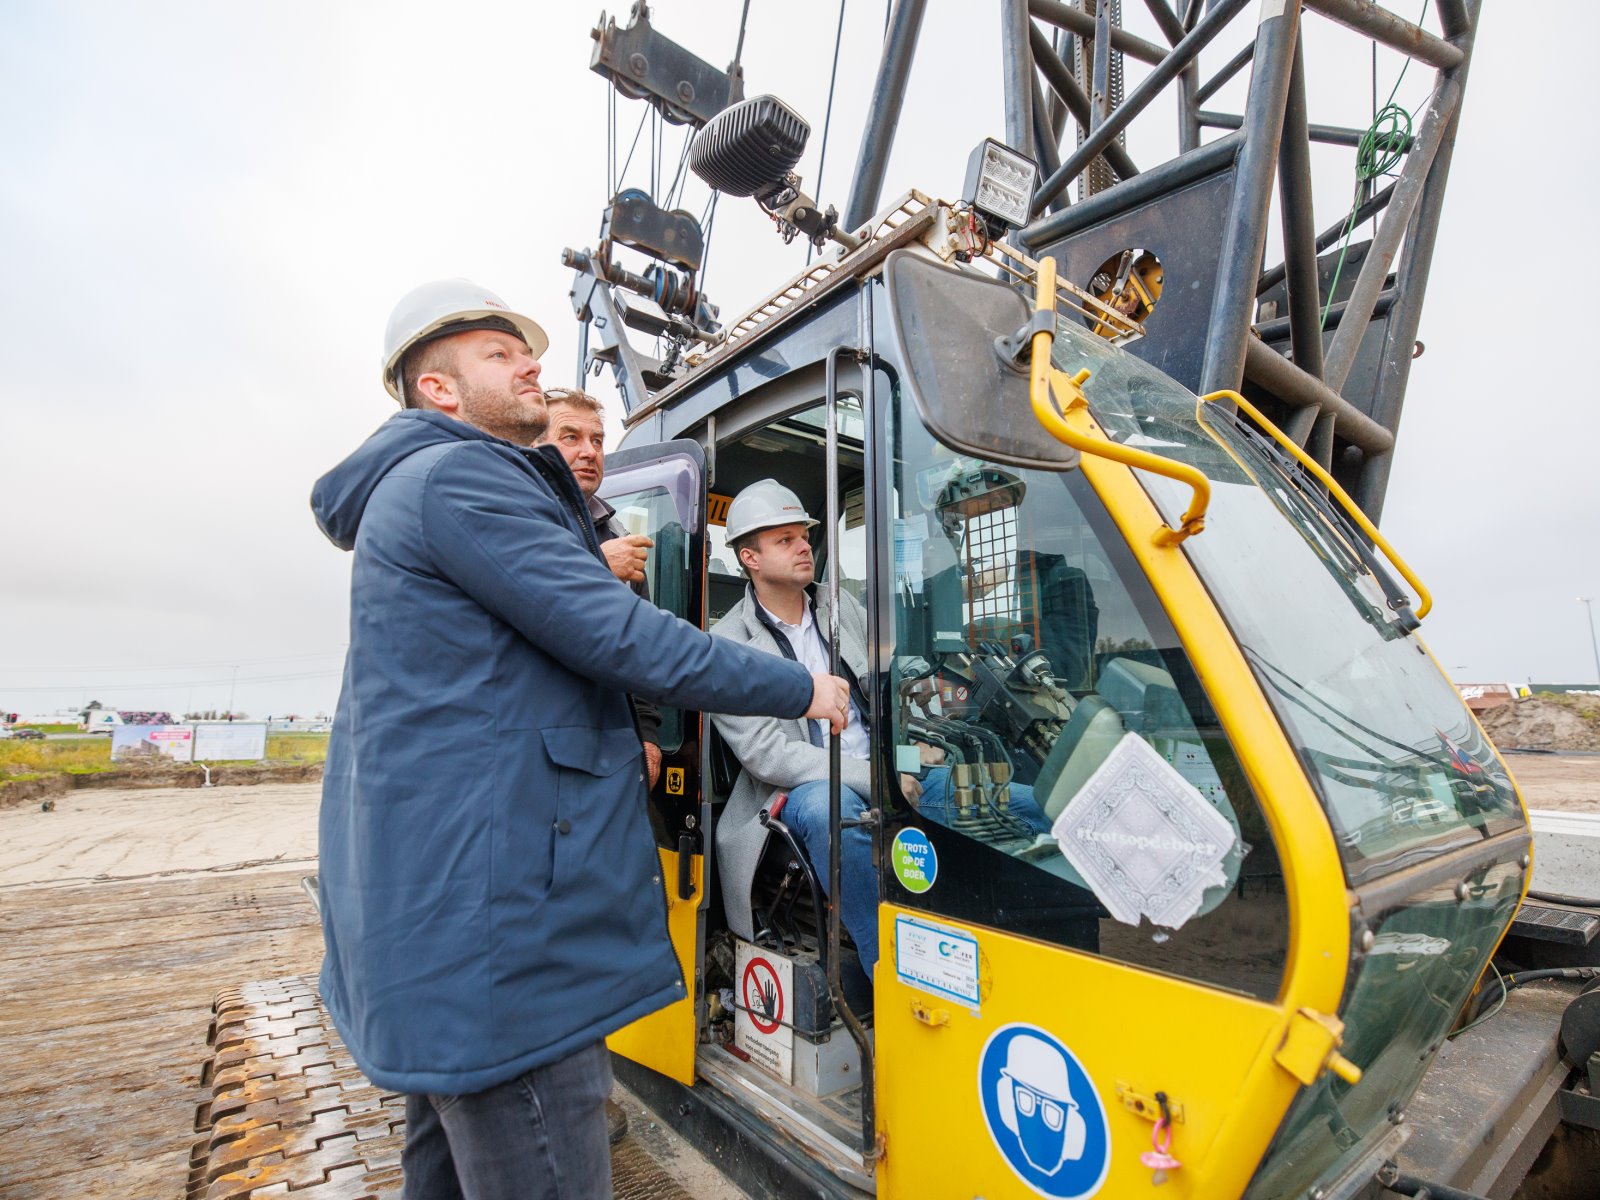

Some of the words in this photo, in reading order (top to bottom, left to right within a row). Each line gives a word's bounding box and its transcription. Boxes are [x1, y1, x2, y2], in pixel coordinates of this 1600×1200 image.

[1076, 827, 1218, 856] #trotsopdeboer
[898, 842, 928, 855] #TROTS
[902, 855, 913, 865] OP
[914, 857, 925, 867] DE
[903, 869, 925, 880] BOER
